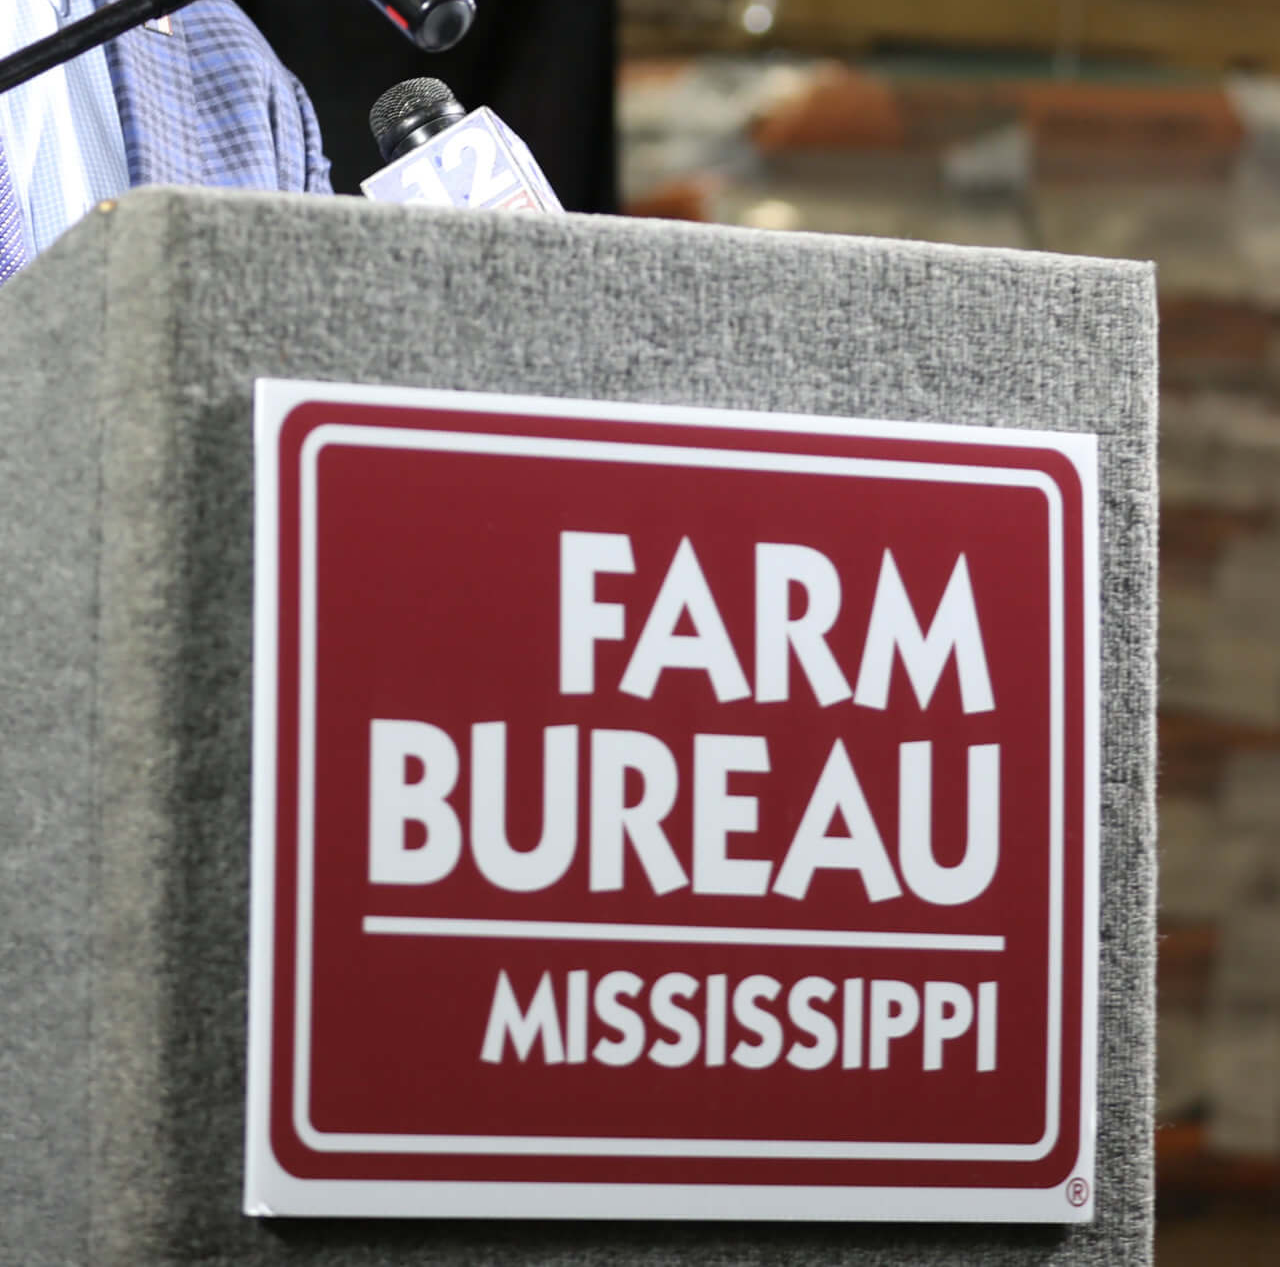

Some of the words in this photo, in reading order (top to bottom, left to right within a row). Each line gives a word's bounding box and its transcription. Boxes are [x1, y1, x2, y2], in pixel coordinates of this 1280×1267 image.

[400, 127, 520, 209] 12
[558, 529, 997, 715] FARM
[367, 717, 1001, 907] BUREAU
[480, 969, 999, 1073] MISSISSIPPI
